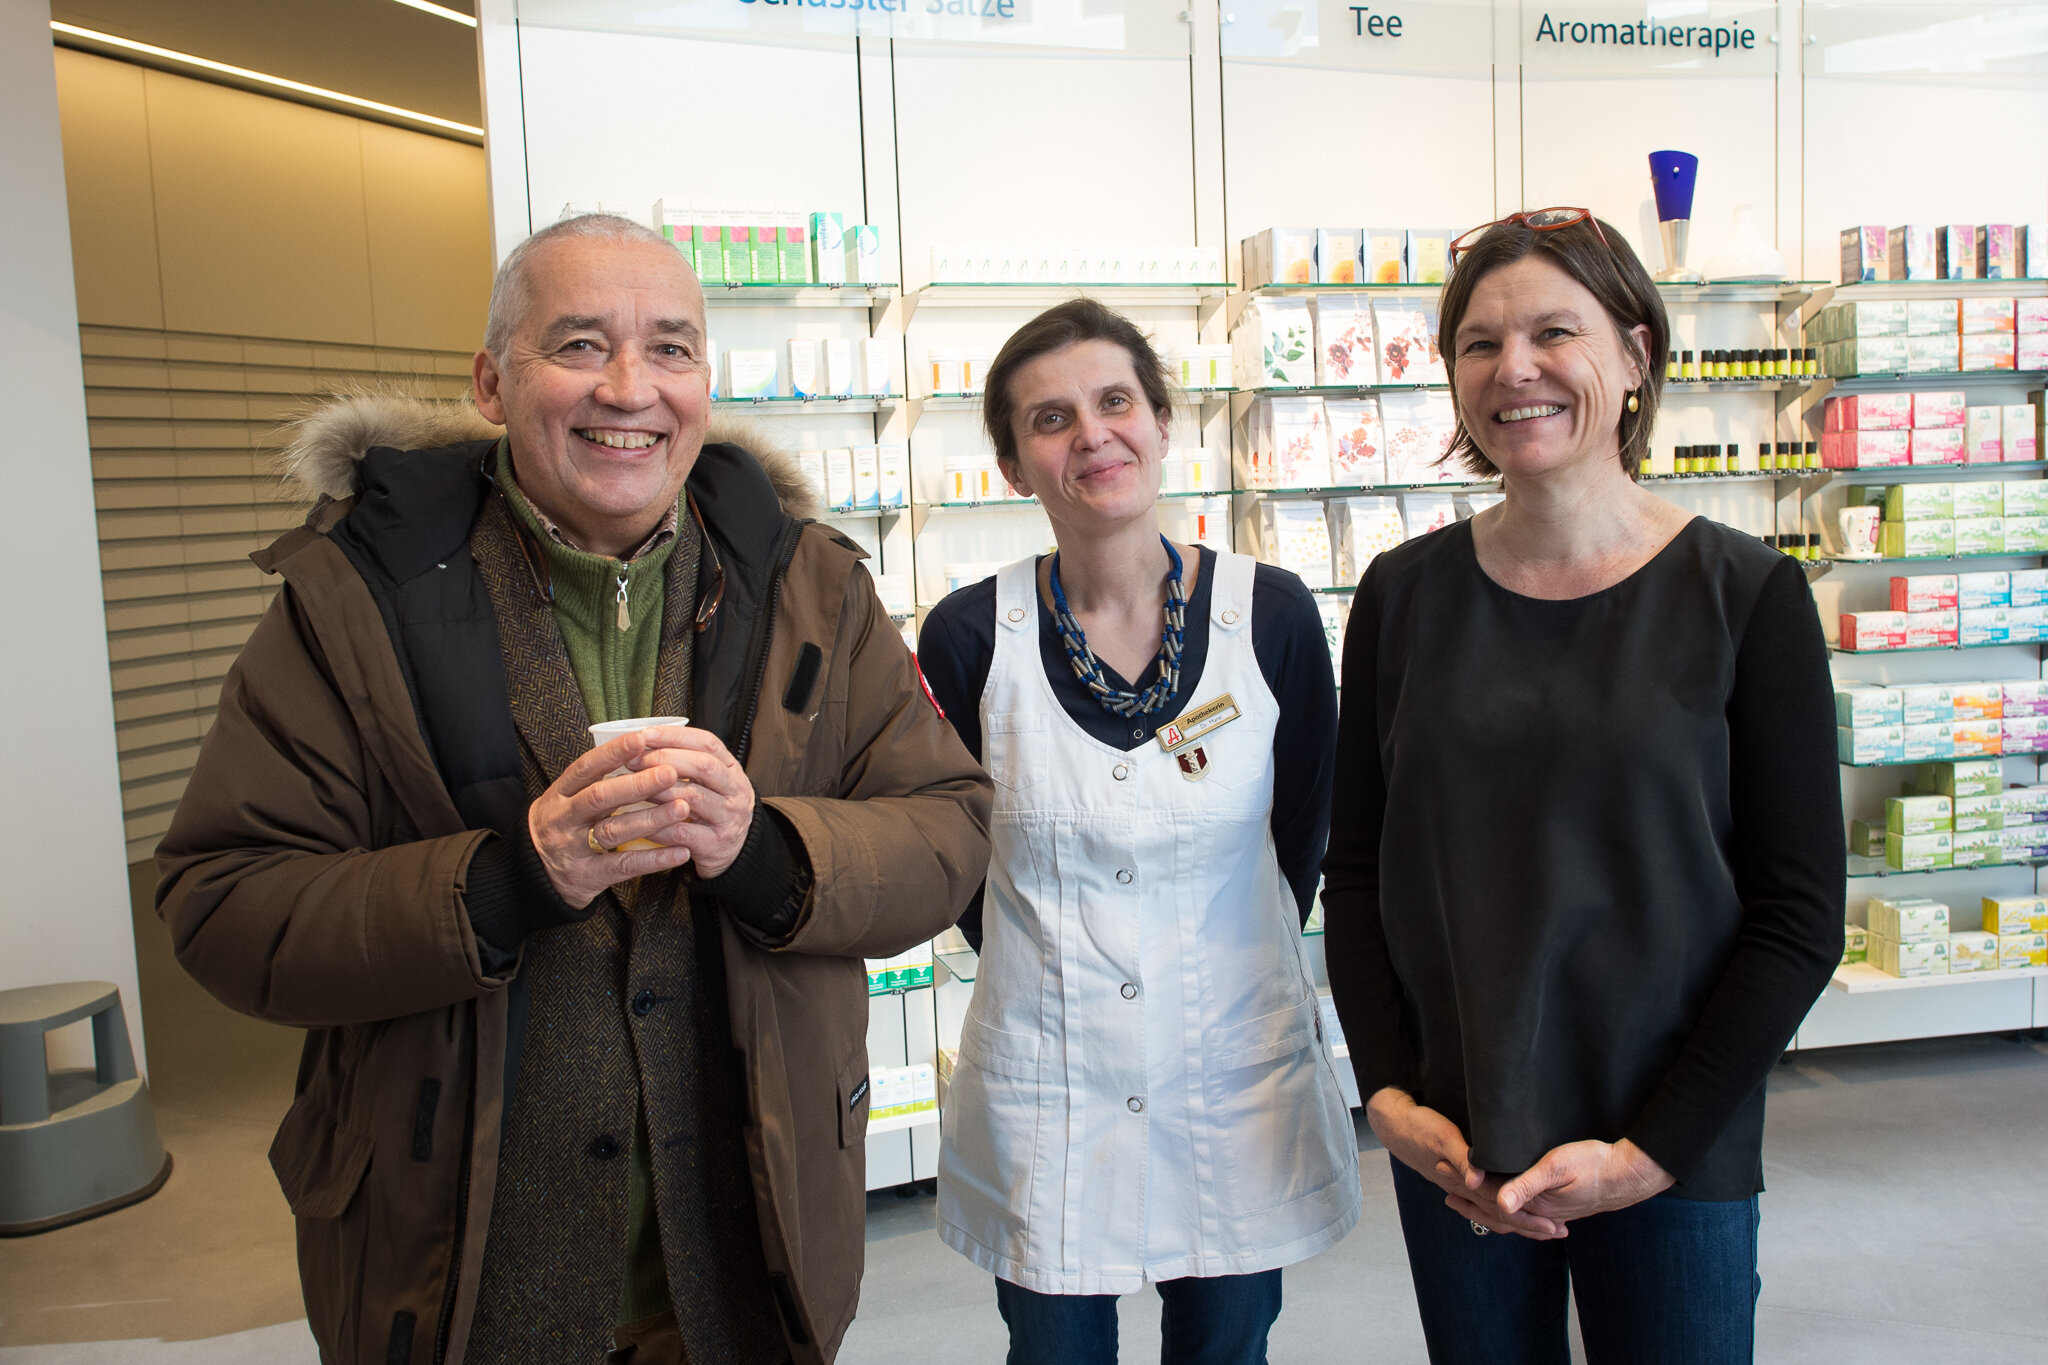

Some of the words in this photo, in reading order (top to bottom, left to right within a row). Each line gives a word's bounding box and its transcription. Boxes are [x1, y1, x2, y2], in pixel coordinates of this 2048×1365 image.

[1349, 6, 1404, 38] Tee
[1535, 13, 1756, 57] Aromatherapie
[1186, 702, 1225, 724] Apothekerin
